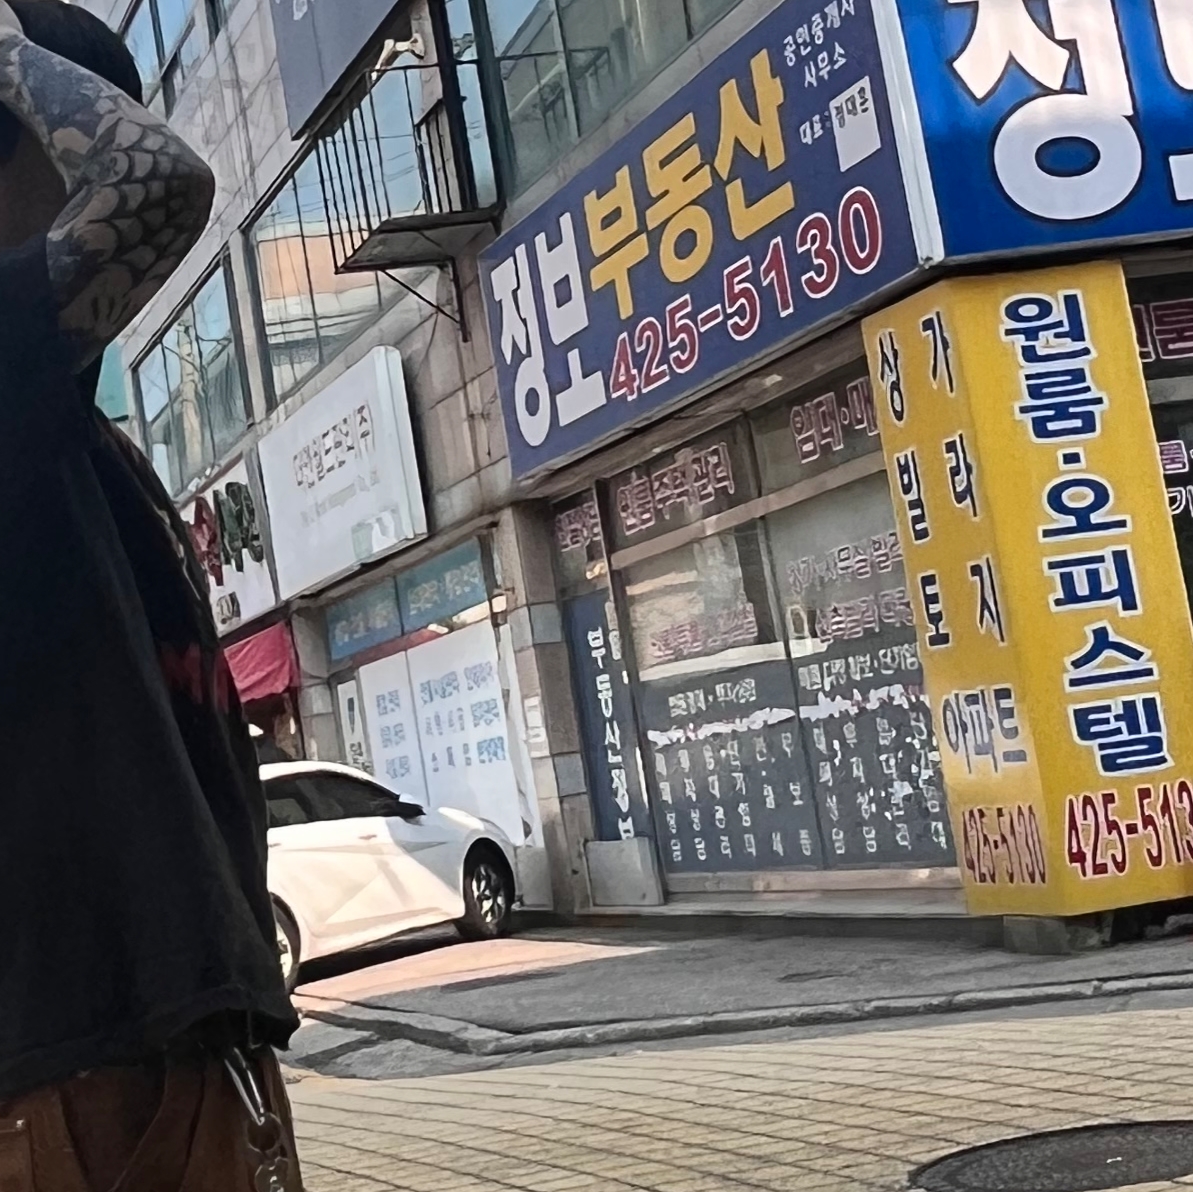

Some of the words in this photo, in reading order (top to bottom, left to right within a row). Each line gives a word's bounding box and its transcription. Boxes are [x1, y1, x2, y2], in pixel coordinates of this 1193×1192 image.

[804, 42, 847, 88] 사무소
[946, 0, 1193, 221] 정
[610, 186, 884, 401] 425-5130
[941, 684, 1028, 775] 아파트
[961, 804, 1047, 885] 425-5130
